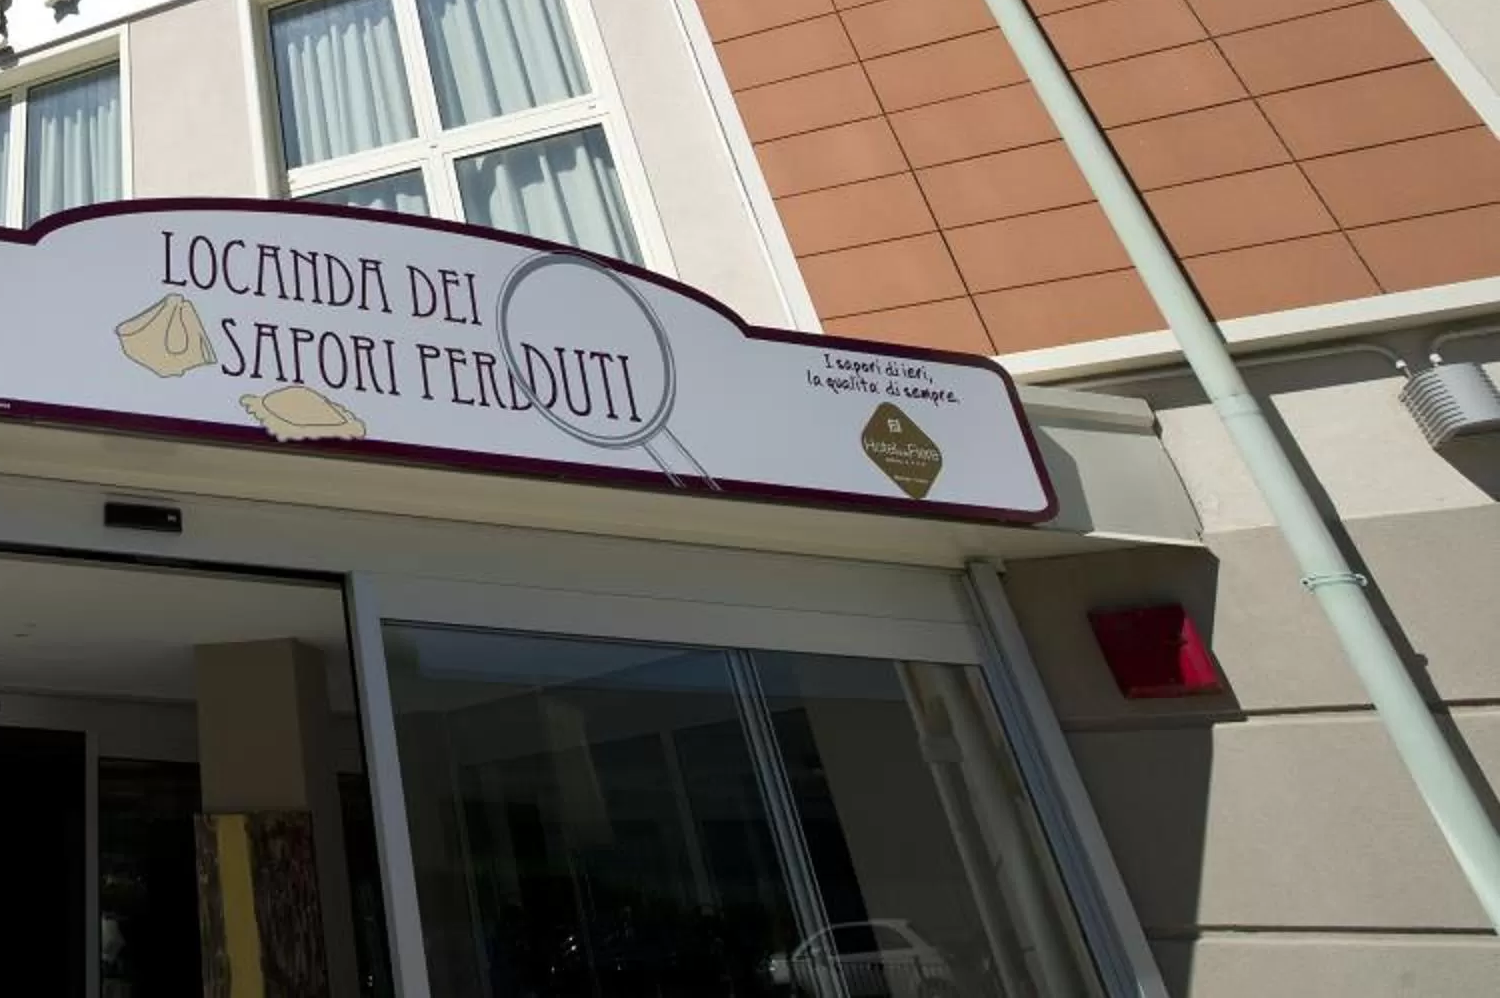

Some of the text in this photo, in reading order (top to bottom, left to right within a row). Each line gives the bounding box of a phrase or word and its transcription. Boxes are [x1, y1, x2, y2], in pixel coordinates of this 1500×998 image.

[161, 230, 482, 326] LOCANDA DEI
[221, 317, 643, 423] SAPORI PERDUTI
[806, 370, 821, 386] la
[836, 357, 881, 376] sapori
